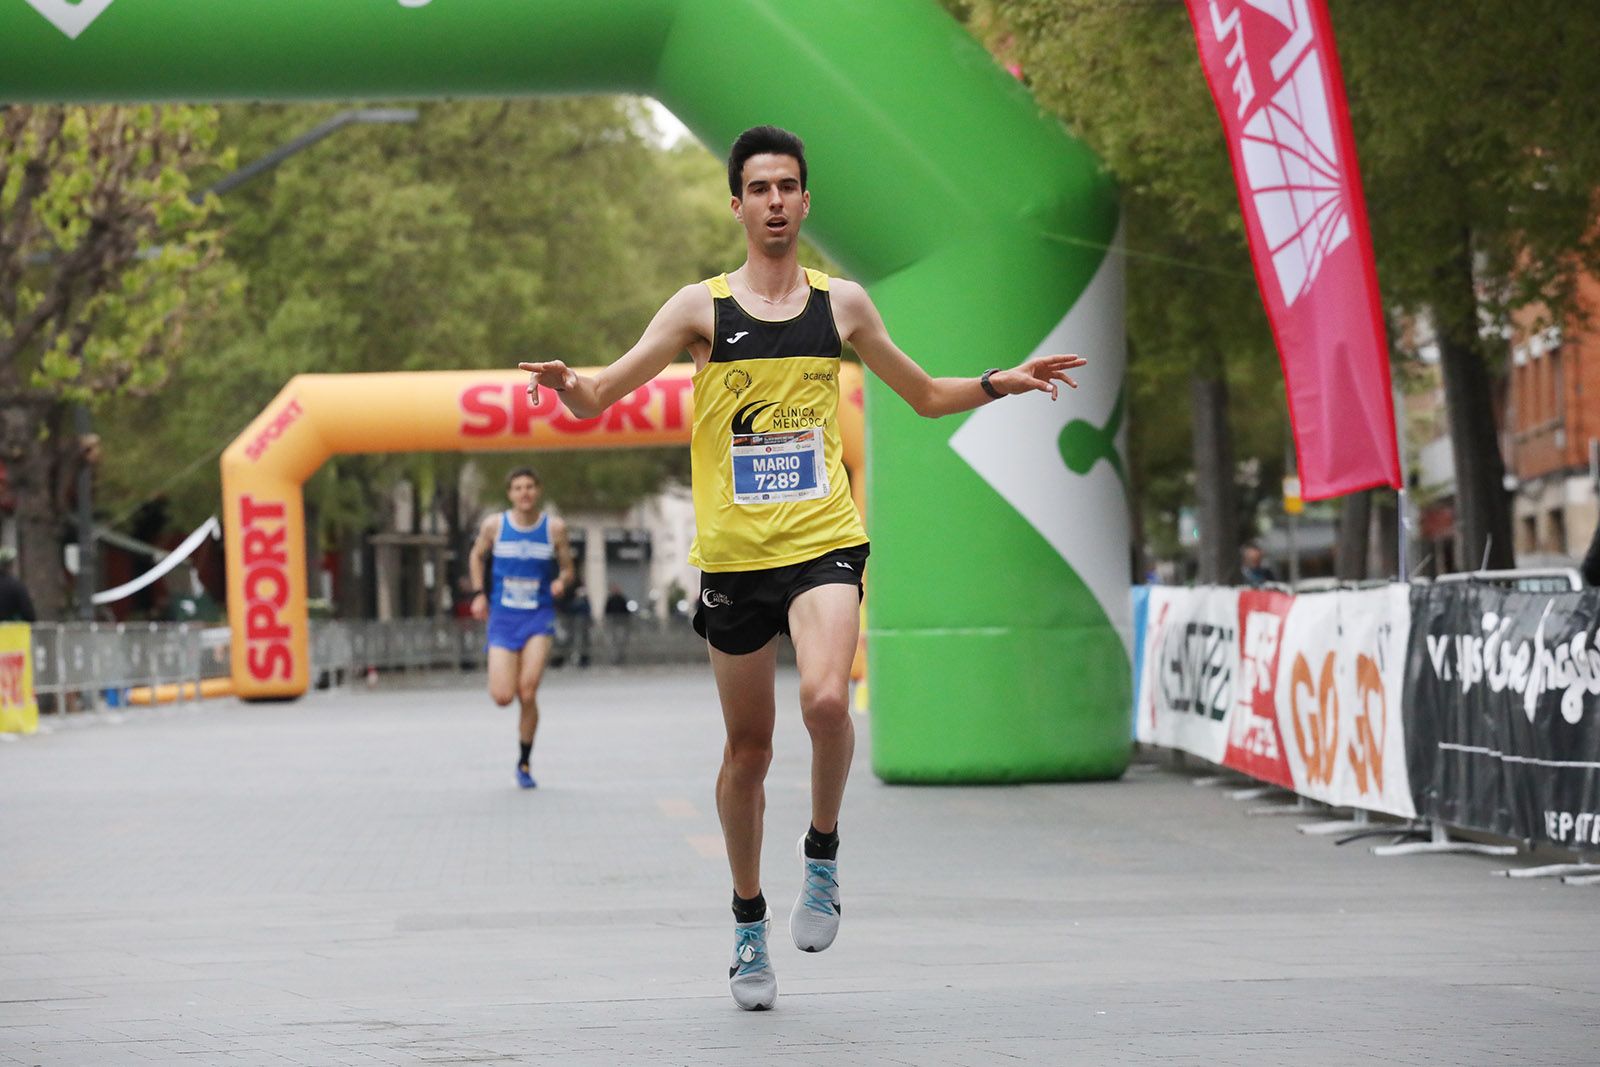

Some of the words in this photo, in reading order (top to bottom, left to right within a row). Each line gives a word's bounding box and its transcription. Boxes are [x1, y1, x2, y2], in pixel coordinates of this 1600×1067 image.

[773, 407, 815, 418] CLÍNICA
[245, 399, 304, 461] SPORT
[752, 455, 801, 472] MARIO
[754, 471, 801, 491] 7289
[239, 495, 293, 682] SPORT
